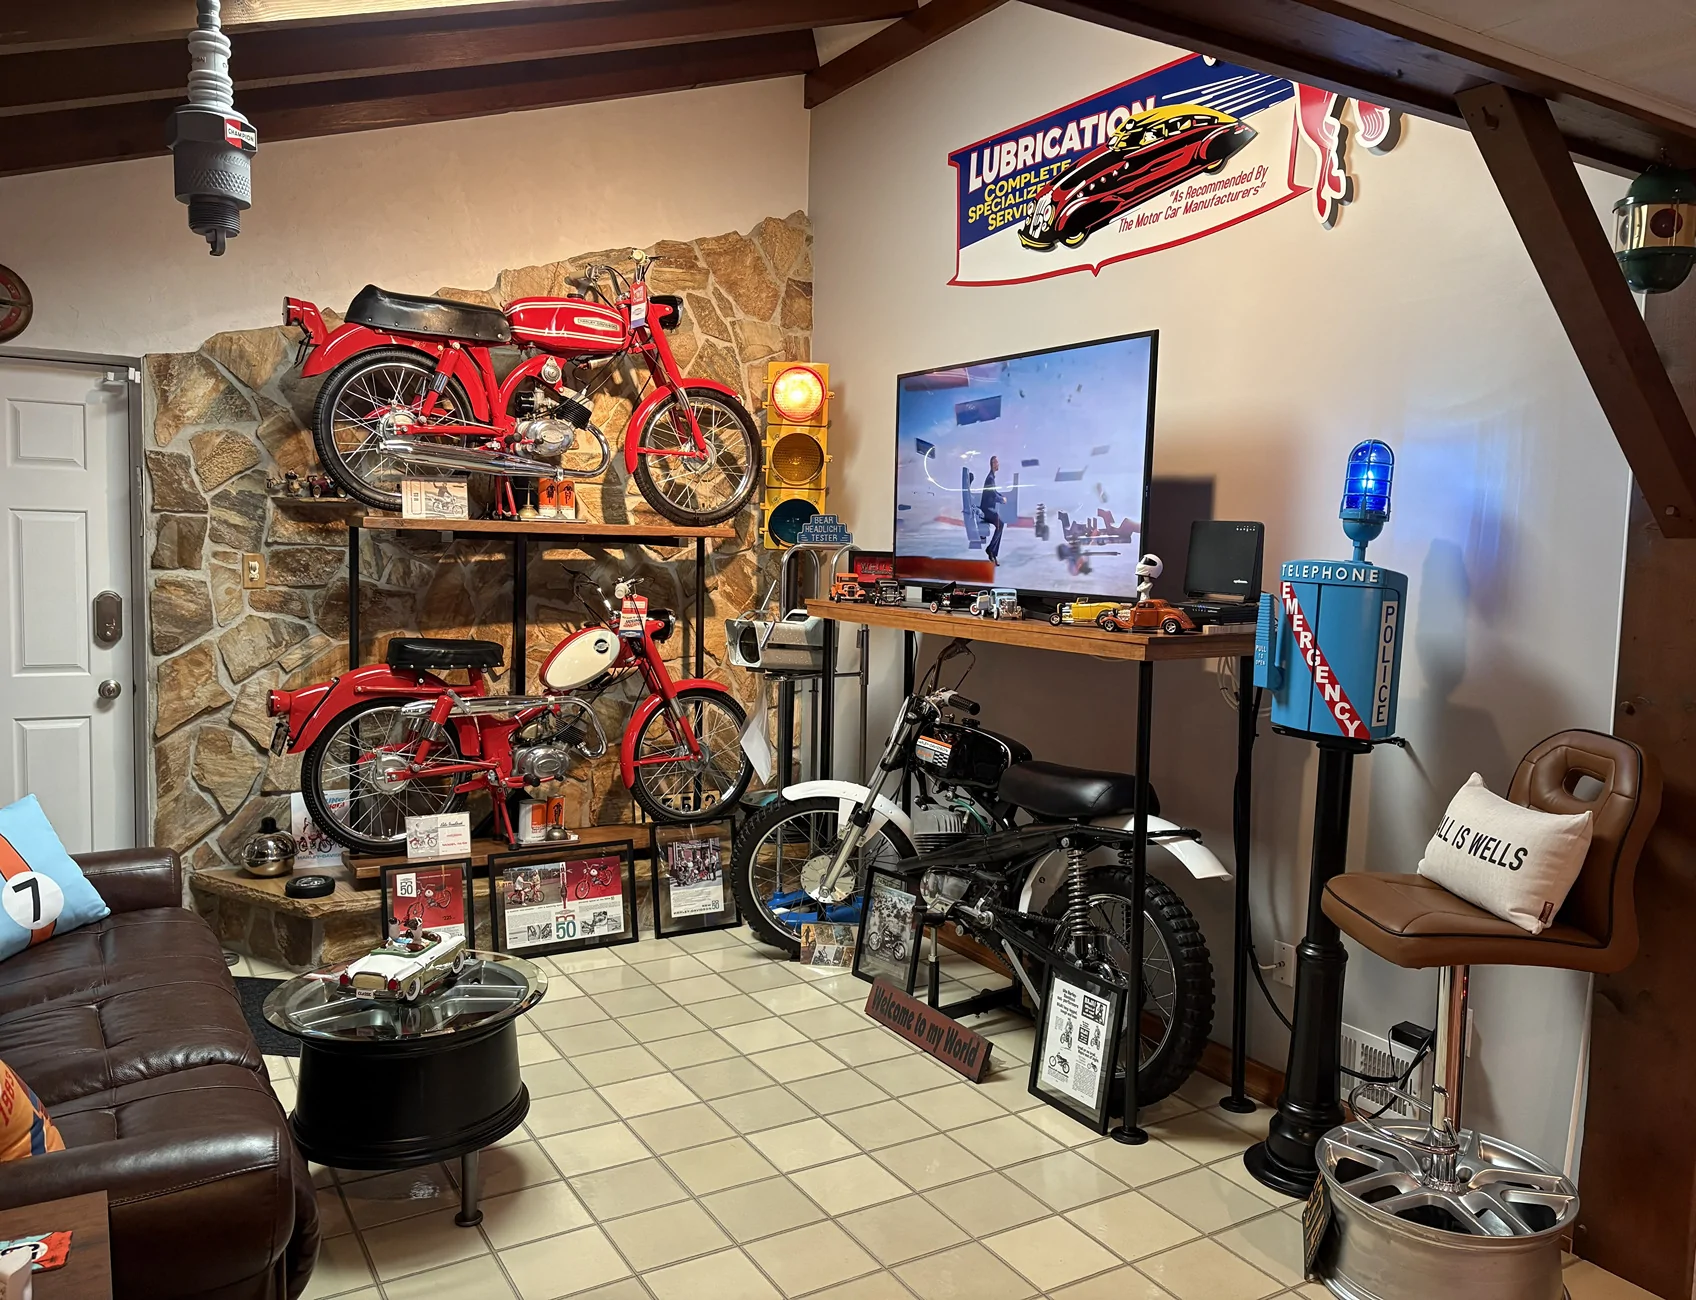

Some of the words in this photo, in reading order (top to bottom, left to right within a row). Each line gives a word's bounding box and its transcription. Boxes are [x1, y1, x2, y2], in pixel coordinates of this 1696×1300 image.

[228, 127, 254, 142] CHAMPION
[968, 182, 1050, 224] SPECIALIZE
[1170, 190, 1183, 204] "As
[1185, 167, 1255, 200] Recommended
[1254, 164, 1269, 182] By
[1118, 218, 1133, 234] The
[1134, 211, 1164, 229] Motor
[1164, 205, 1182, 221] Car
[1182, 181, 1266, 216] Manufacturers"
[805, 525, 842, 533] HEADLIGHT
[814, 516, 834, 524] BEAR
[1281, 564, 1380, 583] TELEPHONE
[1255, 645, 1267, 653] PULL
[1282, 582, 1361, 737] EMERGENCY
[1376, 605, 1395, 723] POLICE
[1451, 825, 1471, 850] IS
[1468, 832, 1529, 871] WELLS
[11, 877, 41, 923] 7
[400, 884, 414, 896] 50
[556, 920, 577, 940] 50
[871, 985, 915, 1031] Welcome
[914, 1012, 927, 1037] to
[926, 1022, 945, 1053] my
[943, 1026, 981, 1068] World
